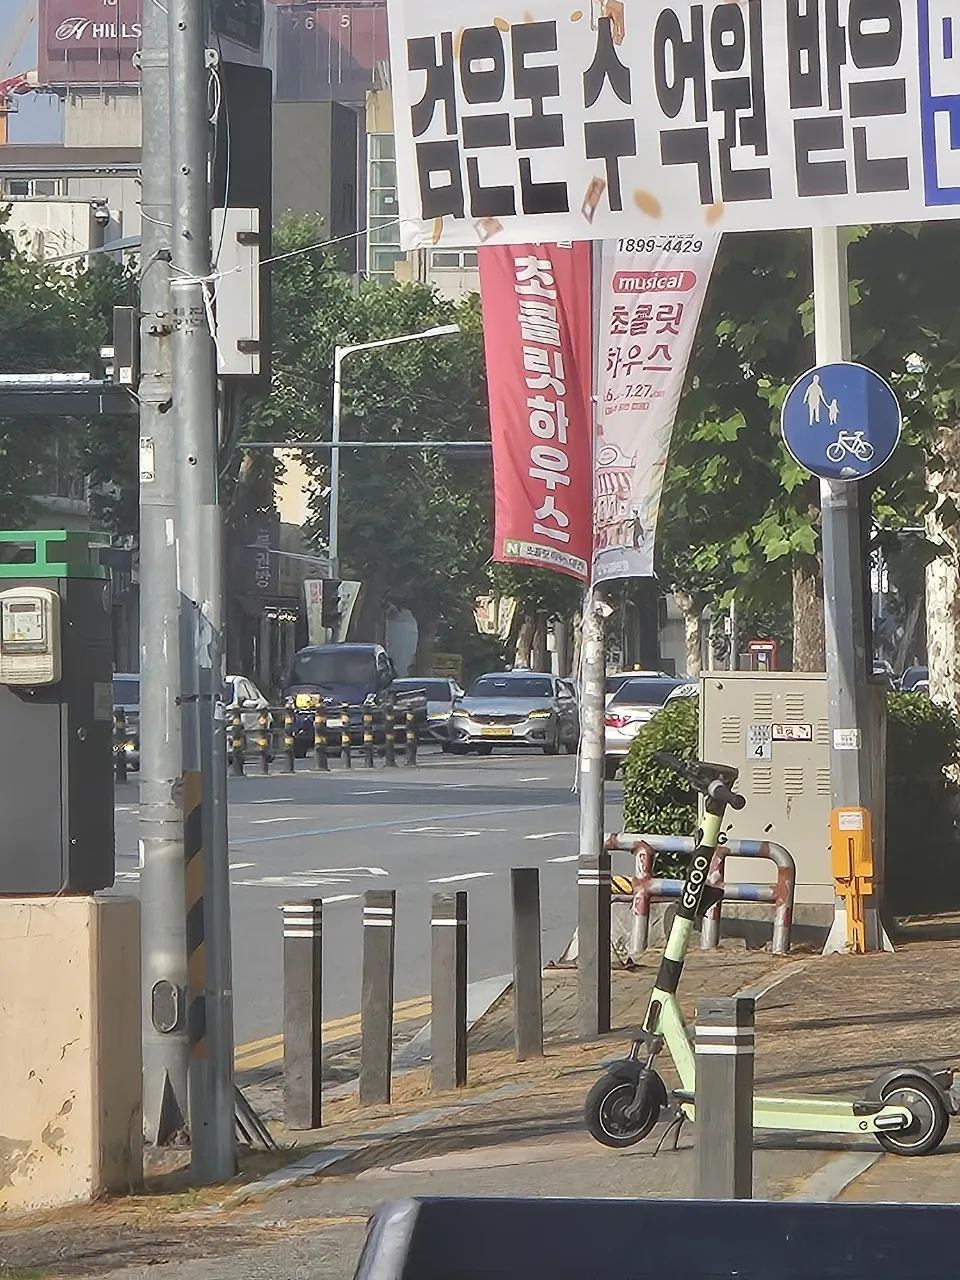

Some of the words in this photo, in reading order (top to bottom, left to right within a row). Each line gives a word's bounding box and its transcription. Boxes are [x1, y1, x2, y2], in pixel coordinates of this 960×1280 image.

[305, 17, 314, 29] 6
[406, 20, 569, 219] 검은돈
[583, 17, 636, 213] 수
[617, 238, 703, 254] 1899-4429
[618, 272, 684, 291] musical
[609, 303, 685, 336] 초콜릿
[514, 255, 570, 543] 초콜릿하우스
[755, 745, 764, 757] 4
[682, 856, 708, 909] GCOO
